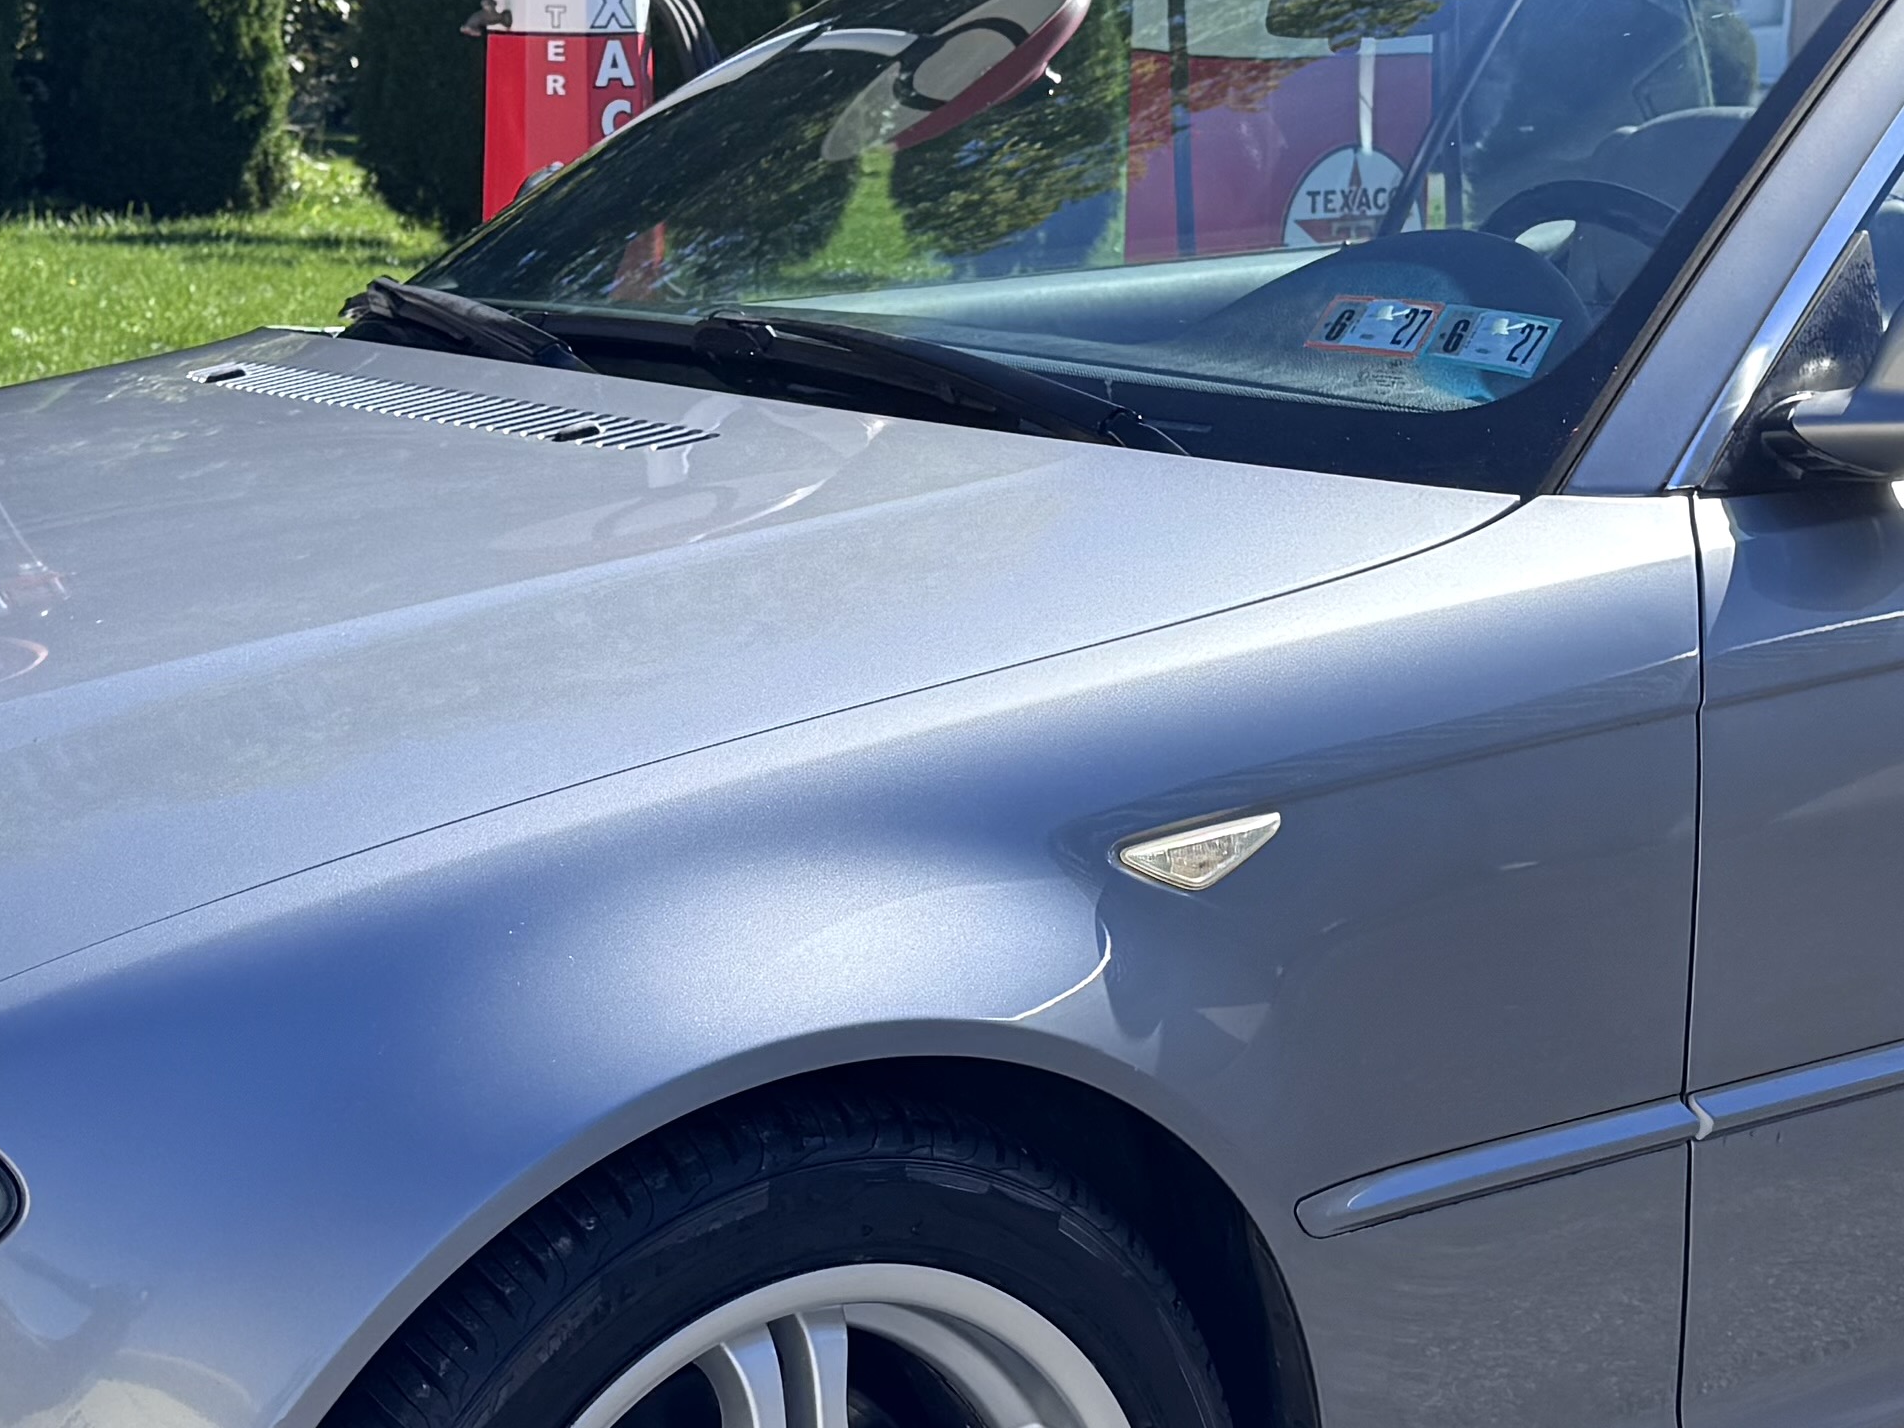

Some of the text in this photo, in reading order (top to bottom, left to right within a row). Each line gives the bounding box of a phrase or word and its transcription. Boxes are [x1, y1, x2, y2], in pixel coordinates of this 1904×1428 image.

[1325, 309, 1355, 341] 6
[1390, 307, 1433, 349] 27
[1442, 318, 1470, 354] 6
[1506, 323, 1549, 366] 27
